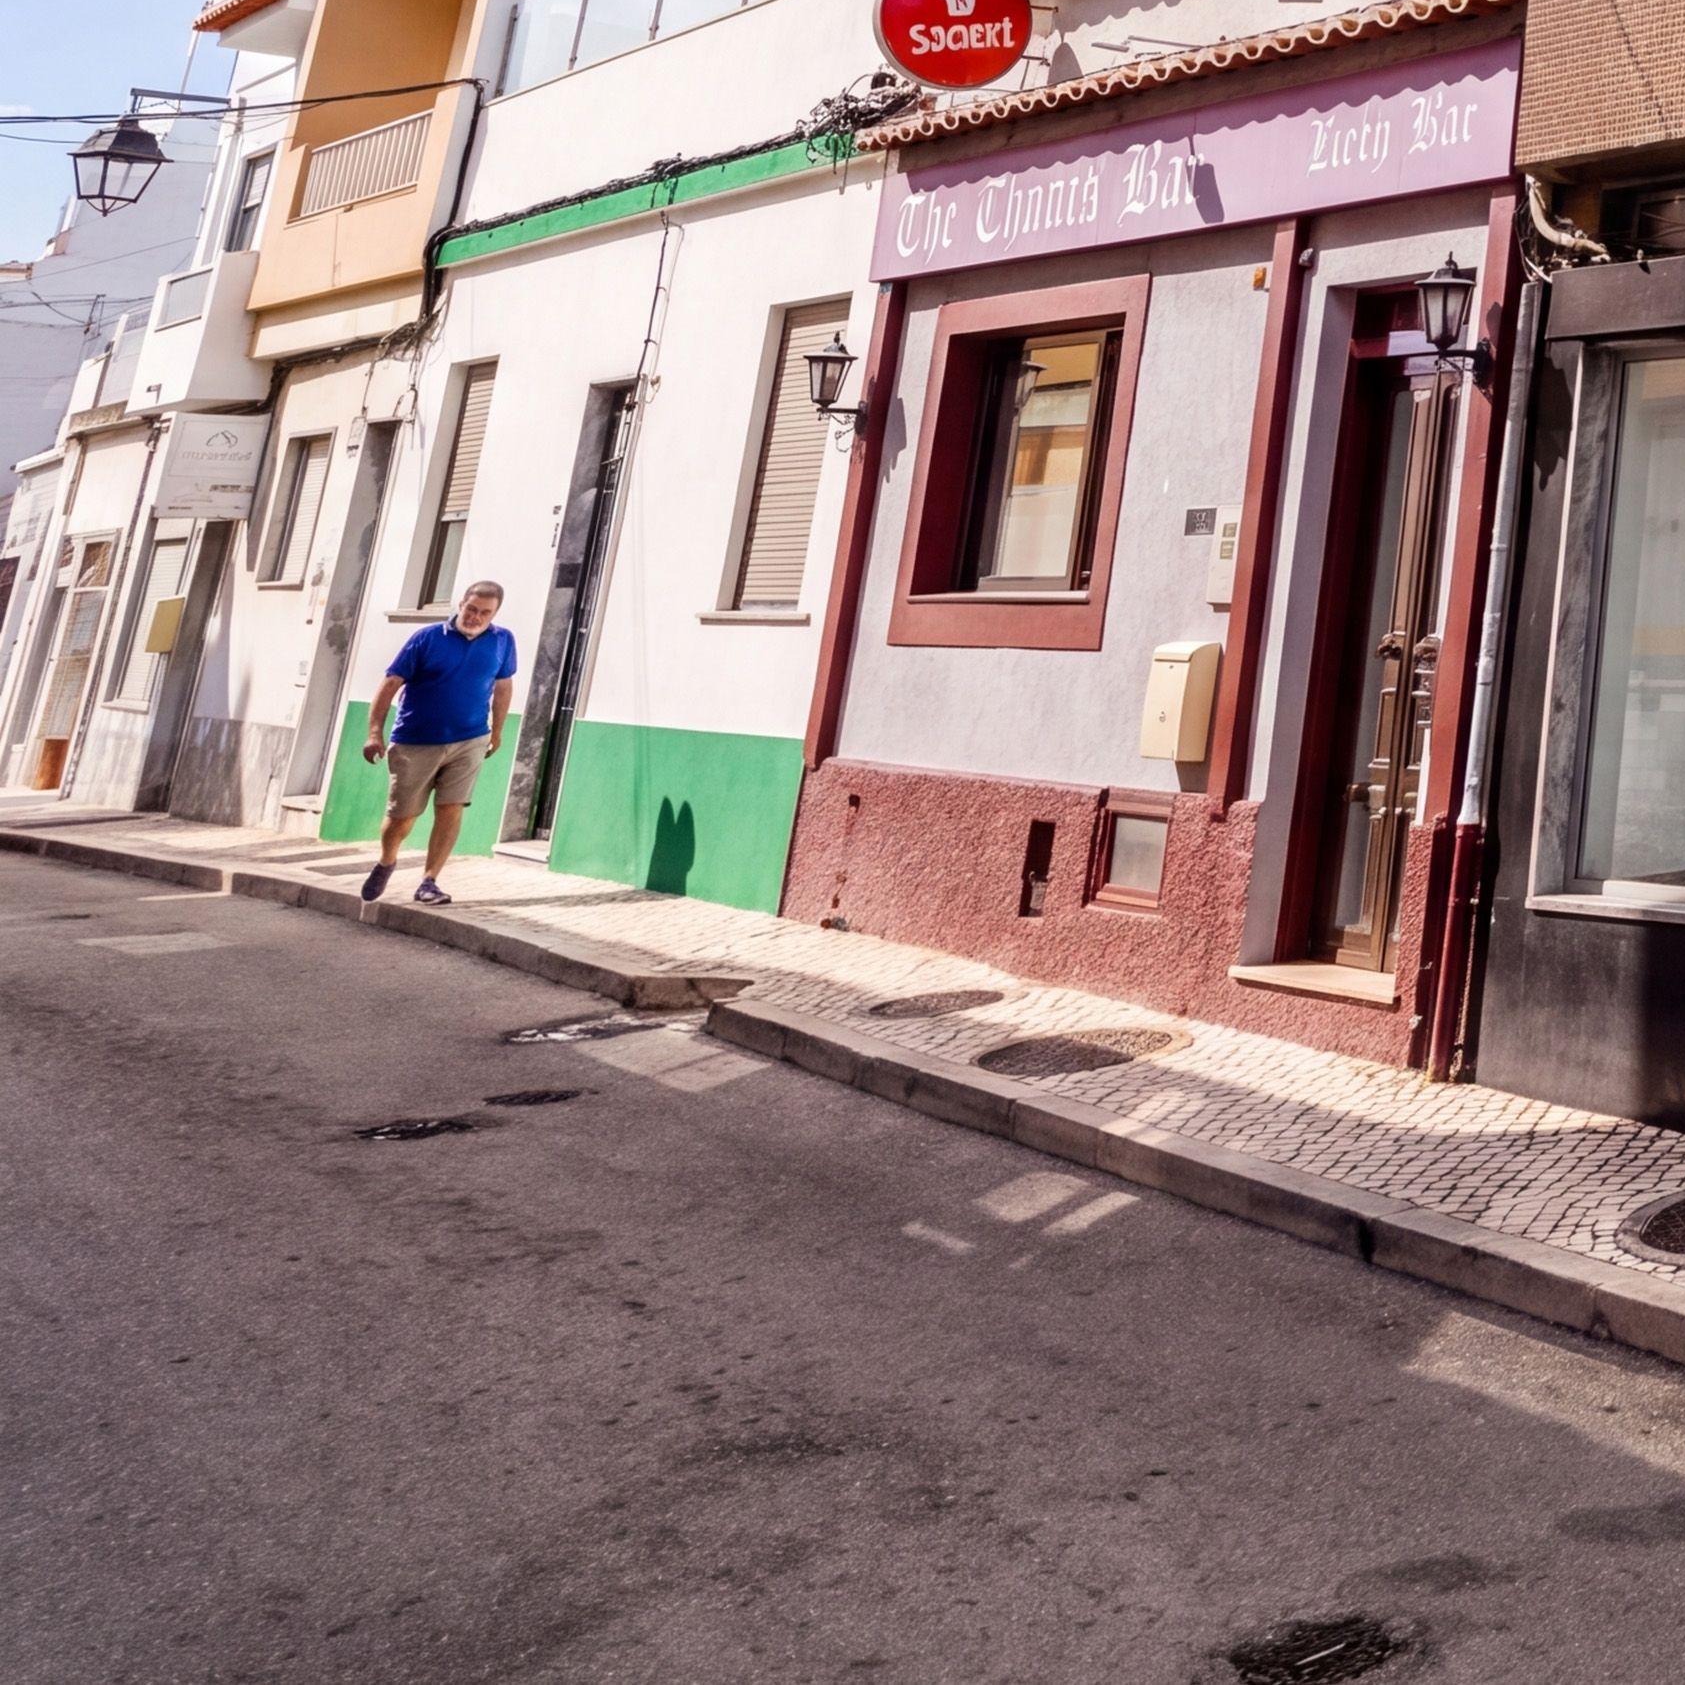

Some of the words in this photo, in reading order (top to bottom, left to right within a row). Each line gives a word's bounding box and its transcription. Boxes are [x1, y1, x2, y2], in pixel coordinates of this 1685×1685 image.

[896, 188, 956, 265] The
[1116, 140, 1205, 227] Bar
[1407, 91, 1478, 155] Bar
